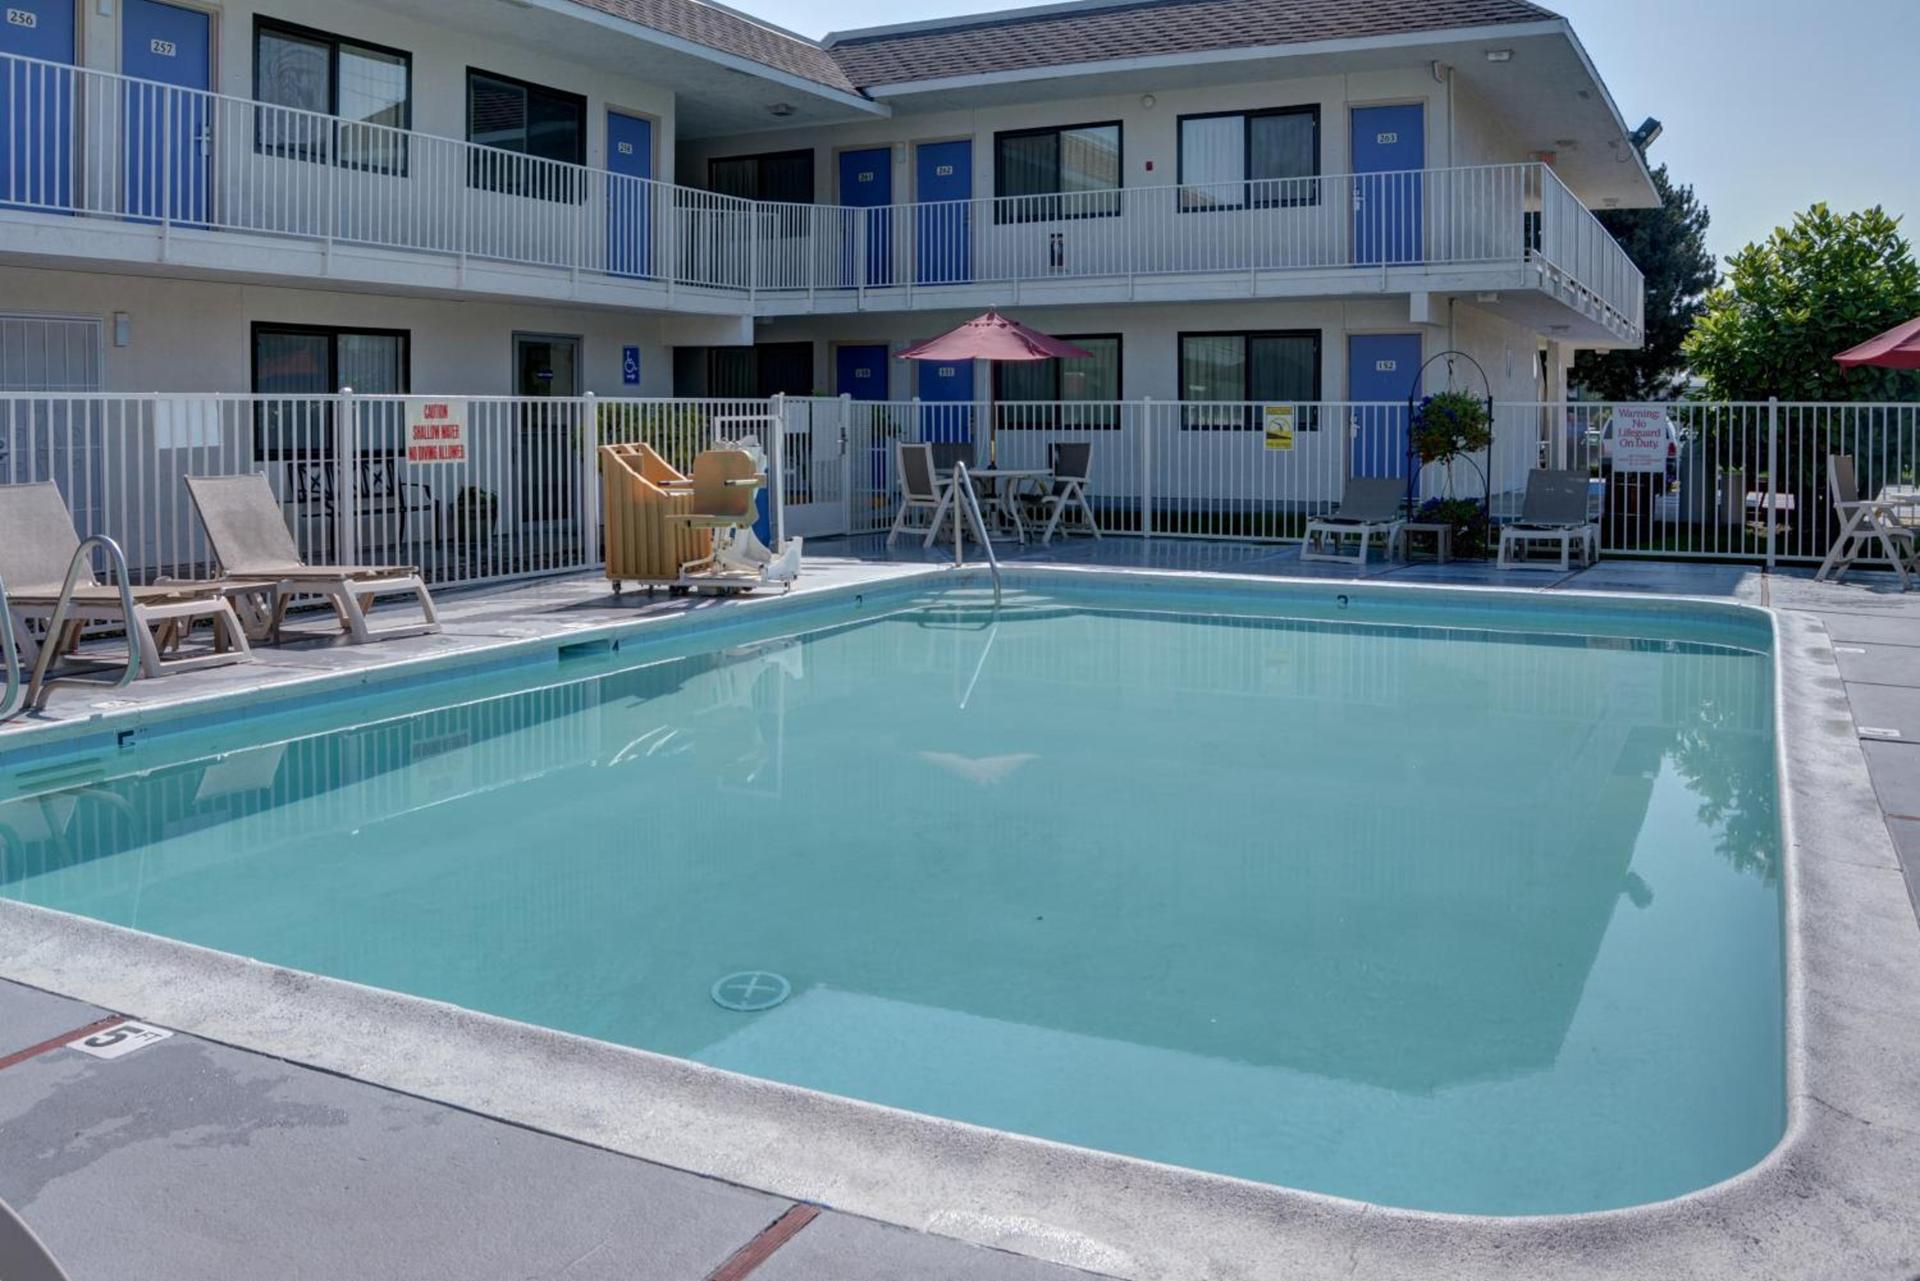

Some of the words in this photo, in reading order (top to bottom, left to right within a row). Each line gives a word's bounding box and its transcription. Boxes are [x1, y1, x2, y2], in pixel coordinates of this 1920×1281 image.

[10, 11, 33, 26] 256
[153, 41, 172, 55] 257
[424, 404, 448, 419] CAUTION
[1632, 419, 1647, 429] No
[413, 424, 440, 440] SHALLOW
[440, 424, 460, 440] WATER
[1618, 428, 1661, 440] Lifeguard
[1619, 439, 1634, 448] On
[409, 446, 417, 461] NO
[418, 446, 438, 461] DIVING
[438, 445, 465, 460] ALLOWED
[84, 1025, 146, 1048] 5
